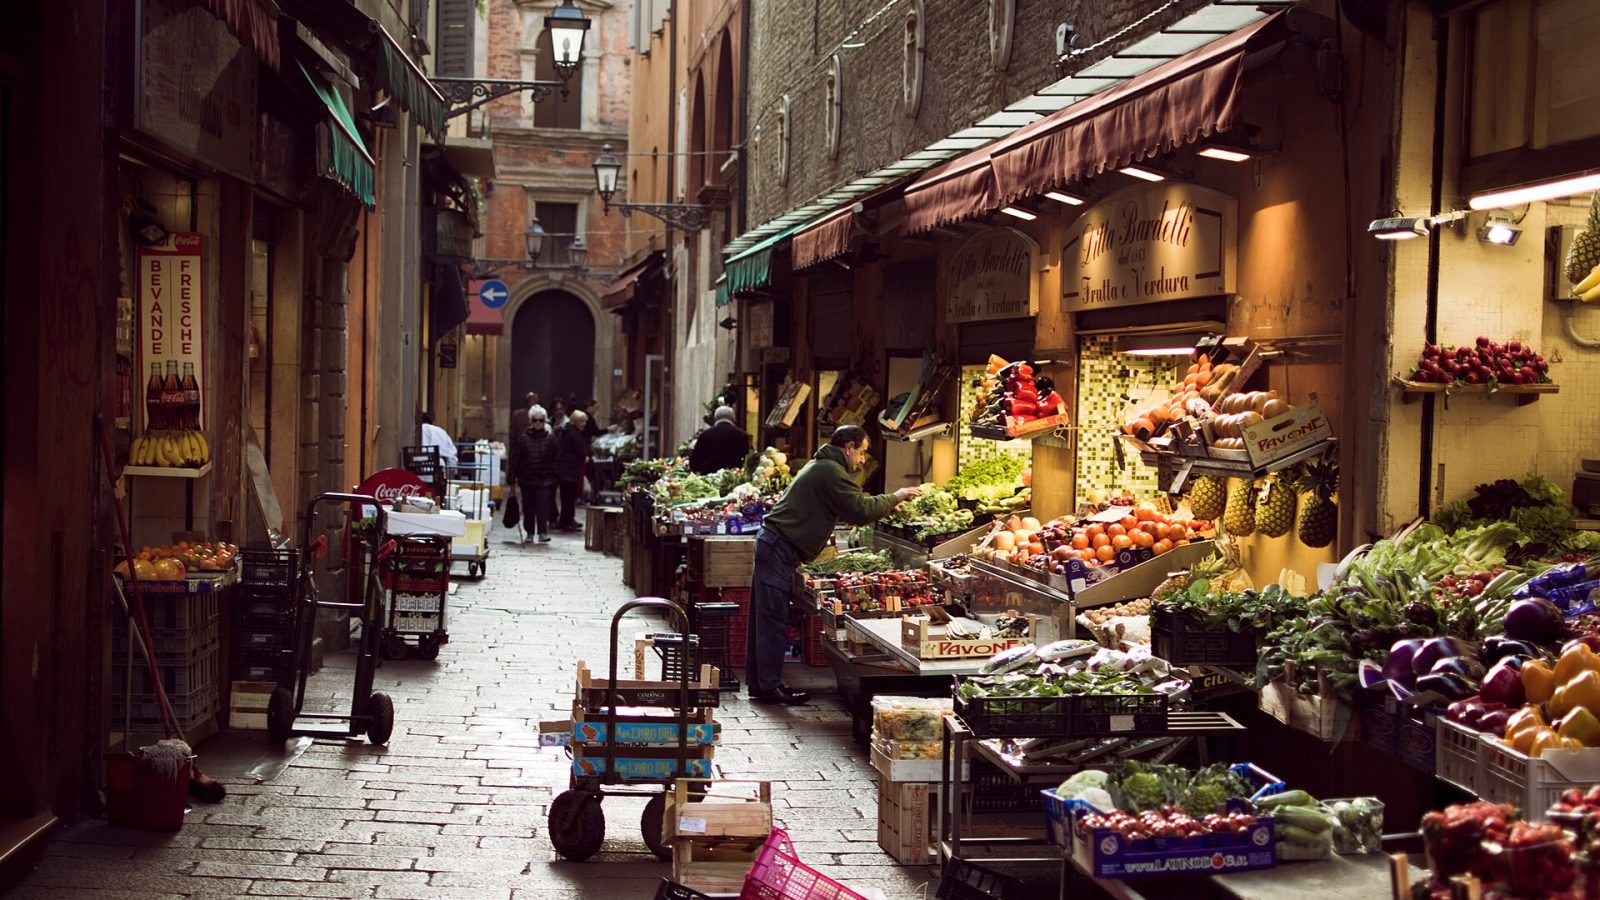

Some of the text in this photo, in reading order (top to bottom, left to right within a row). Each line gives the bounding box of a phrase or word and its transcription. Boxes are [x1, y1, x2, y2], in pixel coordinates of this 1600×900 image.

[1080, 200, 1193, 268] Ditta Bardelli
[978, 239, 1025, 278] Bardelli
[984, 291, 1021, 314] Verdura
[1081, 266, 1189, 305] Frutta e Verdura
[150, 260, 163, 354] BEVANDE
[180, 260, 192, 354] FRESCHE
[1258, 416, 1325, 452] PAVONE
